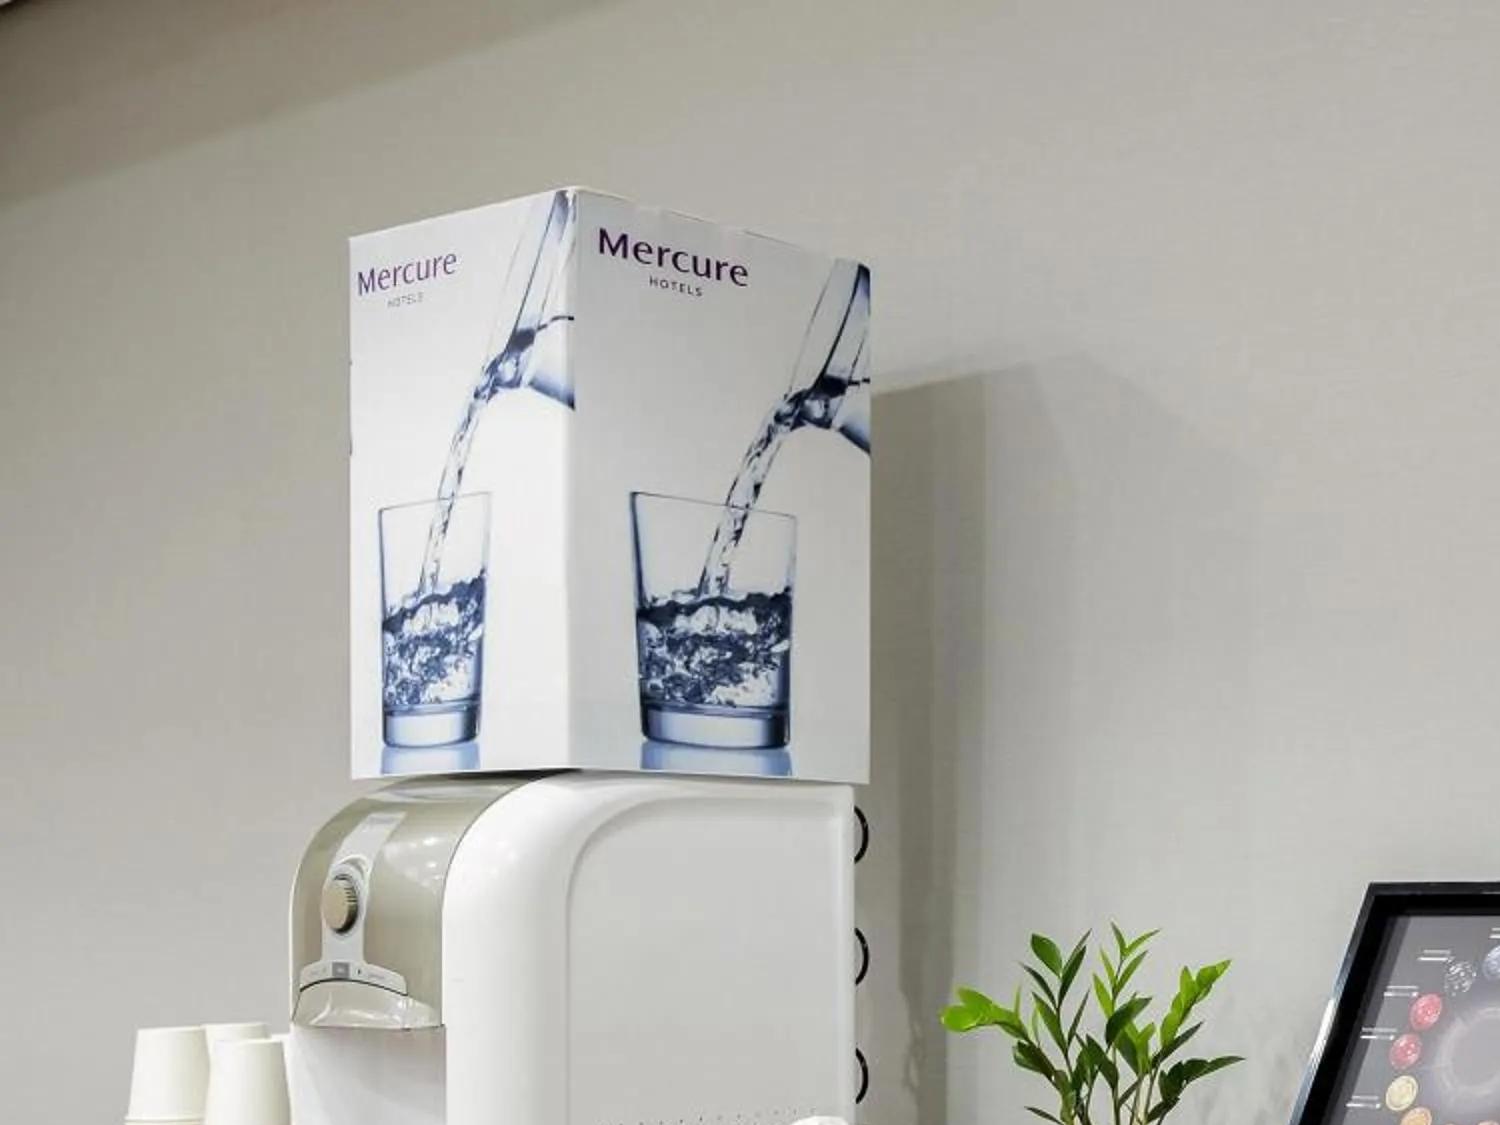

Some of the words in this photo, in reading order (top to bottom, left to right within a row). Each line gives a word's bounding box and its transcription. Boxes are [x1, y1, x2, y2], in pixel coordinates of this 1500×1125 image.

[357, 253, 457, 296] Mercure
[599, 227, 749, 287] Mercure
[649, 275, 703, 297] HOTELS
